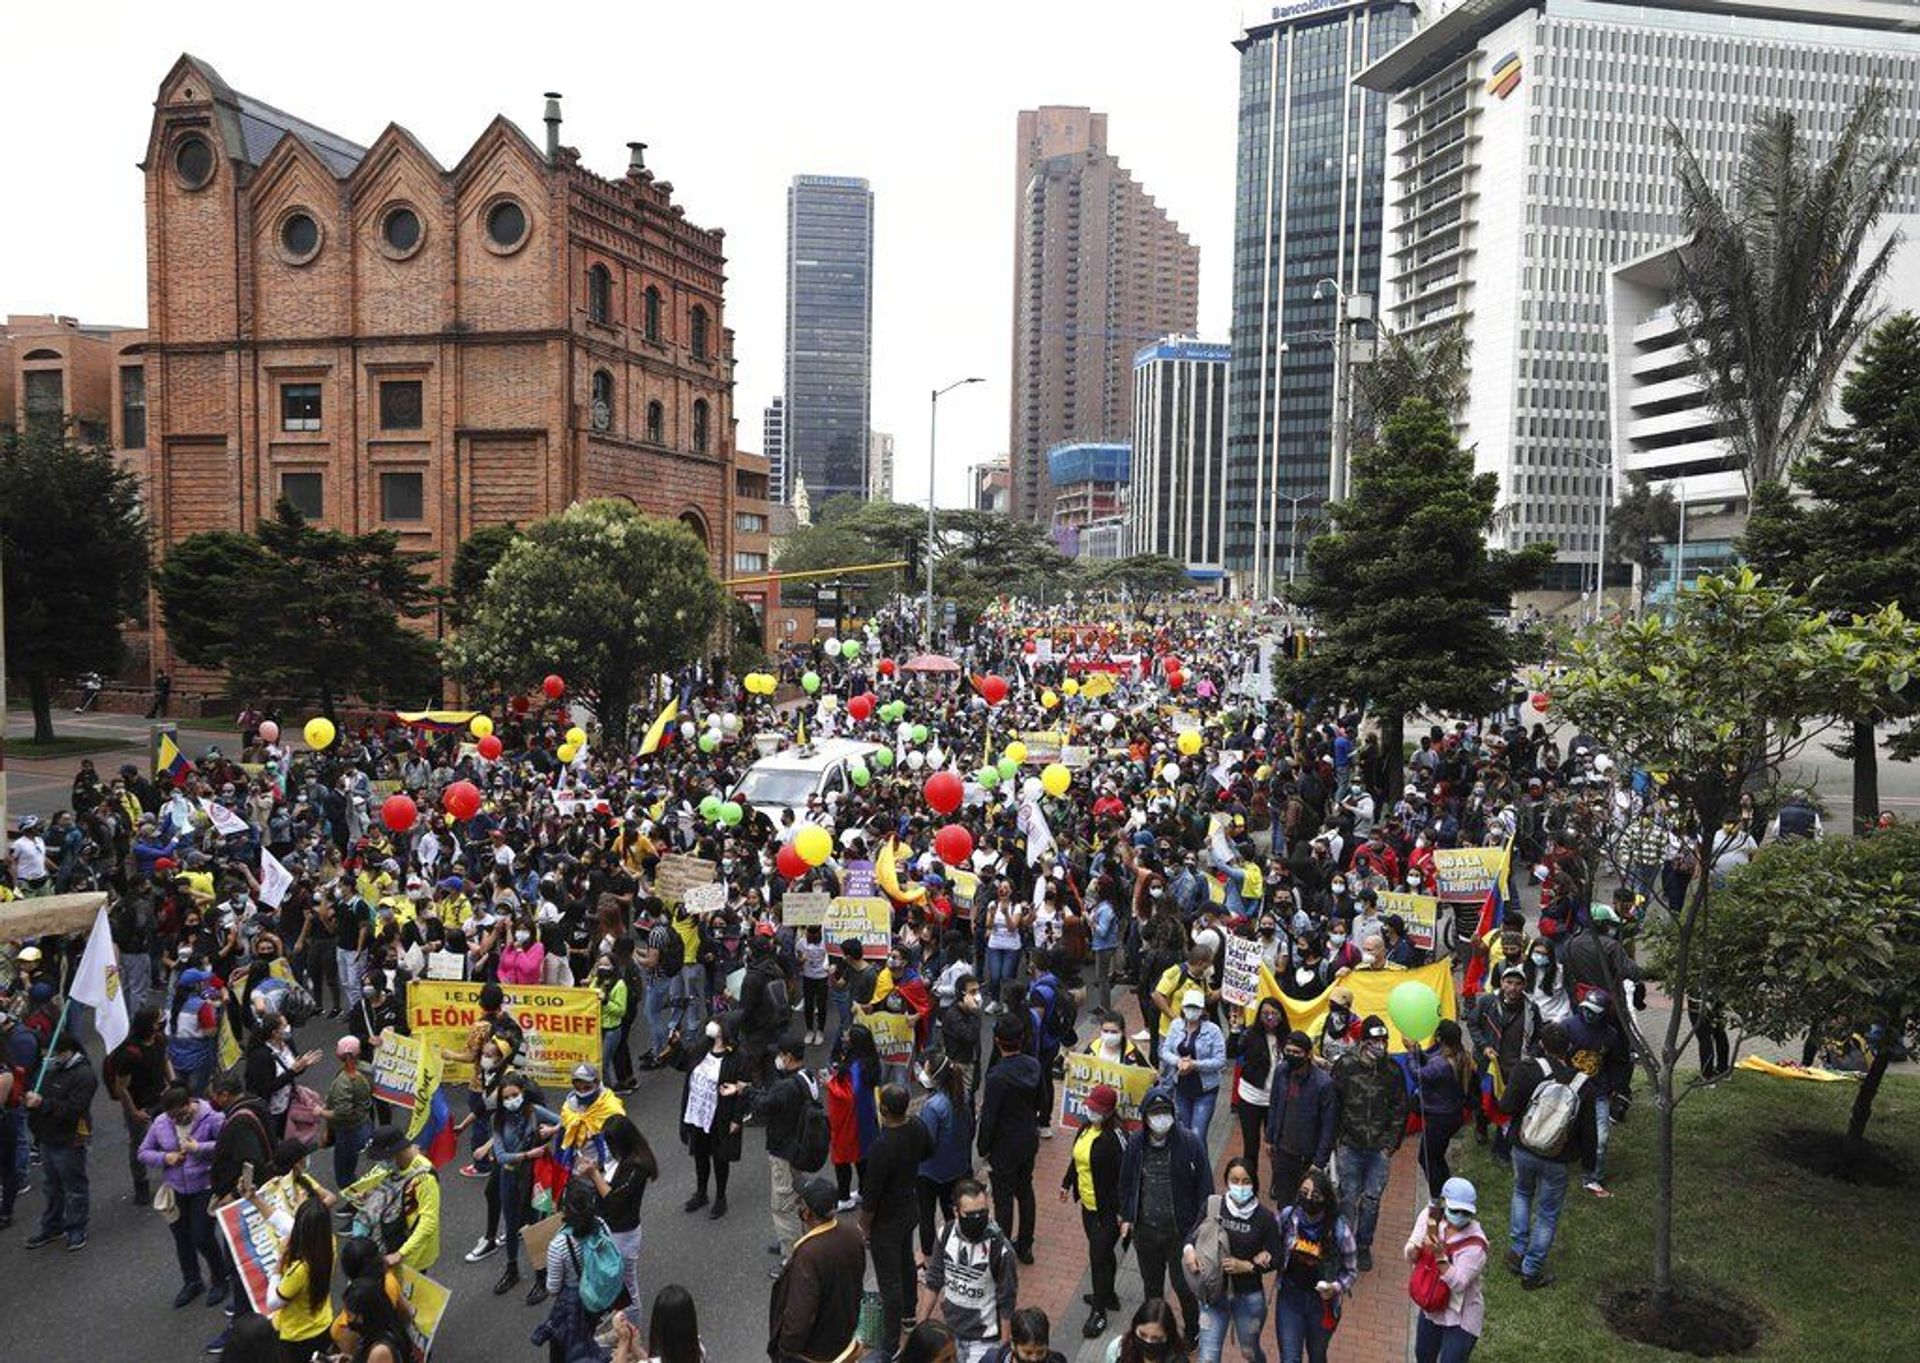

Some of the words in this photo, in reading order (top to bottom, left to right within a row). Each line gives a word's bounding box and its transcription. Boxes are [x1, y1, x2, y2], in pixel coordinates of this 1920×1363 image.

[1440, 857, 1456, 868] NO
[1457, 857, 1465, 867] A
[1466, 856, 1483, 867] LA
[853, 904, 868, 917] LA
[503, 995, 564, 1007] OLEGIO
[416, 1005, 475, 1027] LEÓN
[519, 1011, 597, 1034] GREIFF
[374, 1056, 418, 1081] REFORM
[374, 1066, 420, 1098] TRIBUTA
[1105, 1071, 1124, 1090] LA
